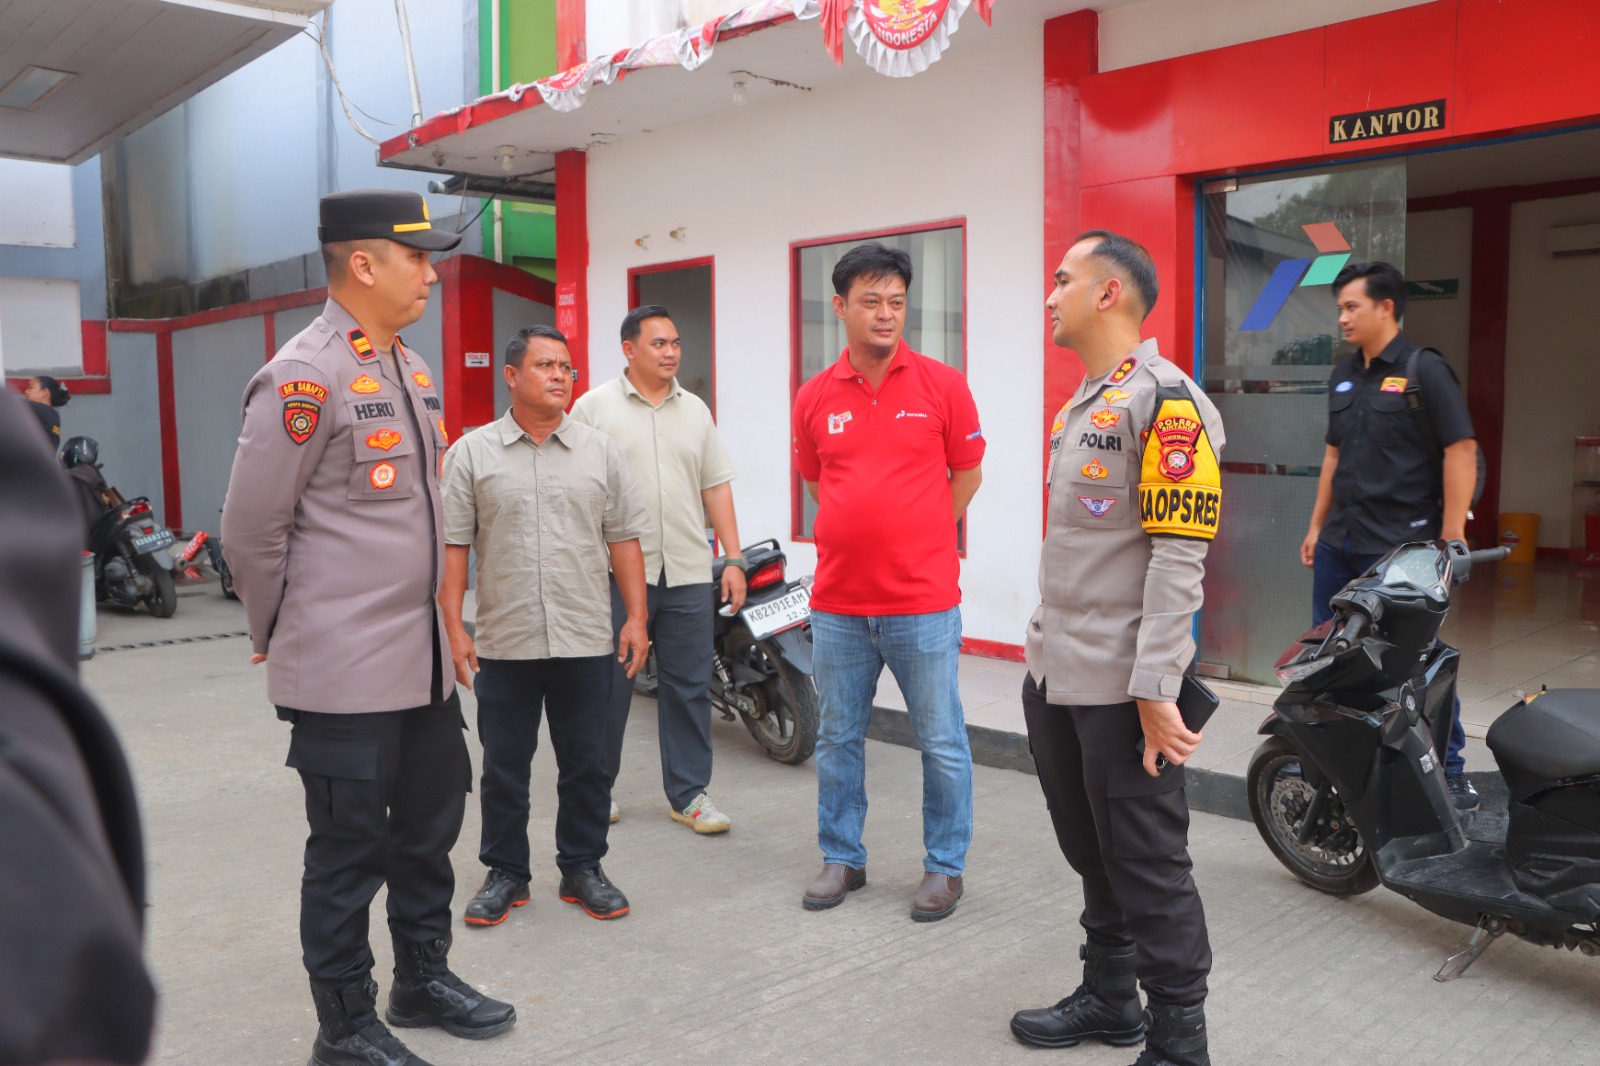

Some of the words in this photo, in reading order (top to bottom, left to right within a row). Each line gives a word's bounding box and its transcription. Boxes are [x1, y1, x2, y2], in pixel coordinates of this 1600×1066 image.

[872, 9, 939, 46] INDONESIA
[1333, 107, 1439, 141] KANTOR
[283, 383, 295, 394] SAT
[297, 381, 326, 399] SAMAPTA
[354, 402, 395, 420] HERU
[1157, 417, 1198, 429] POLRES
[1079, 432, 1122, 451] POLRI
